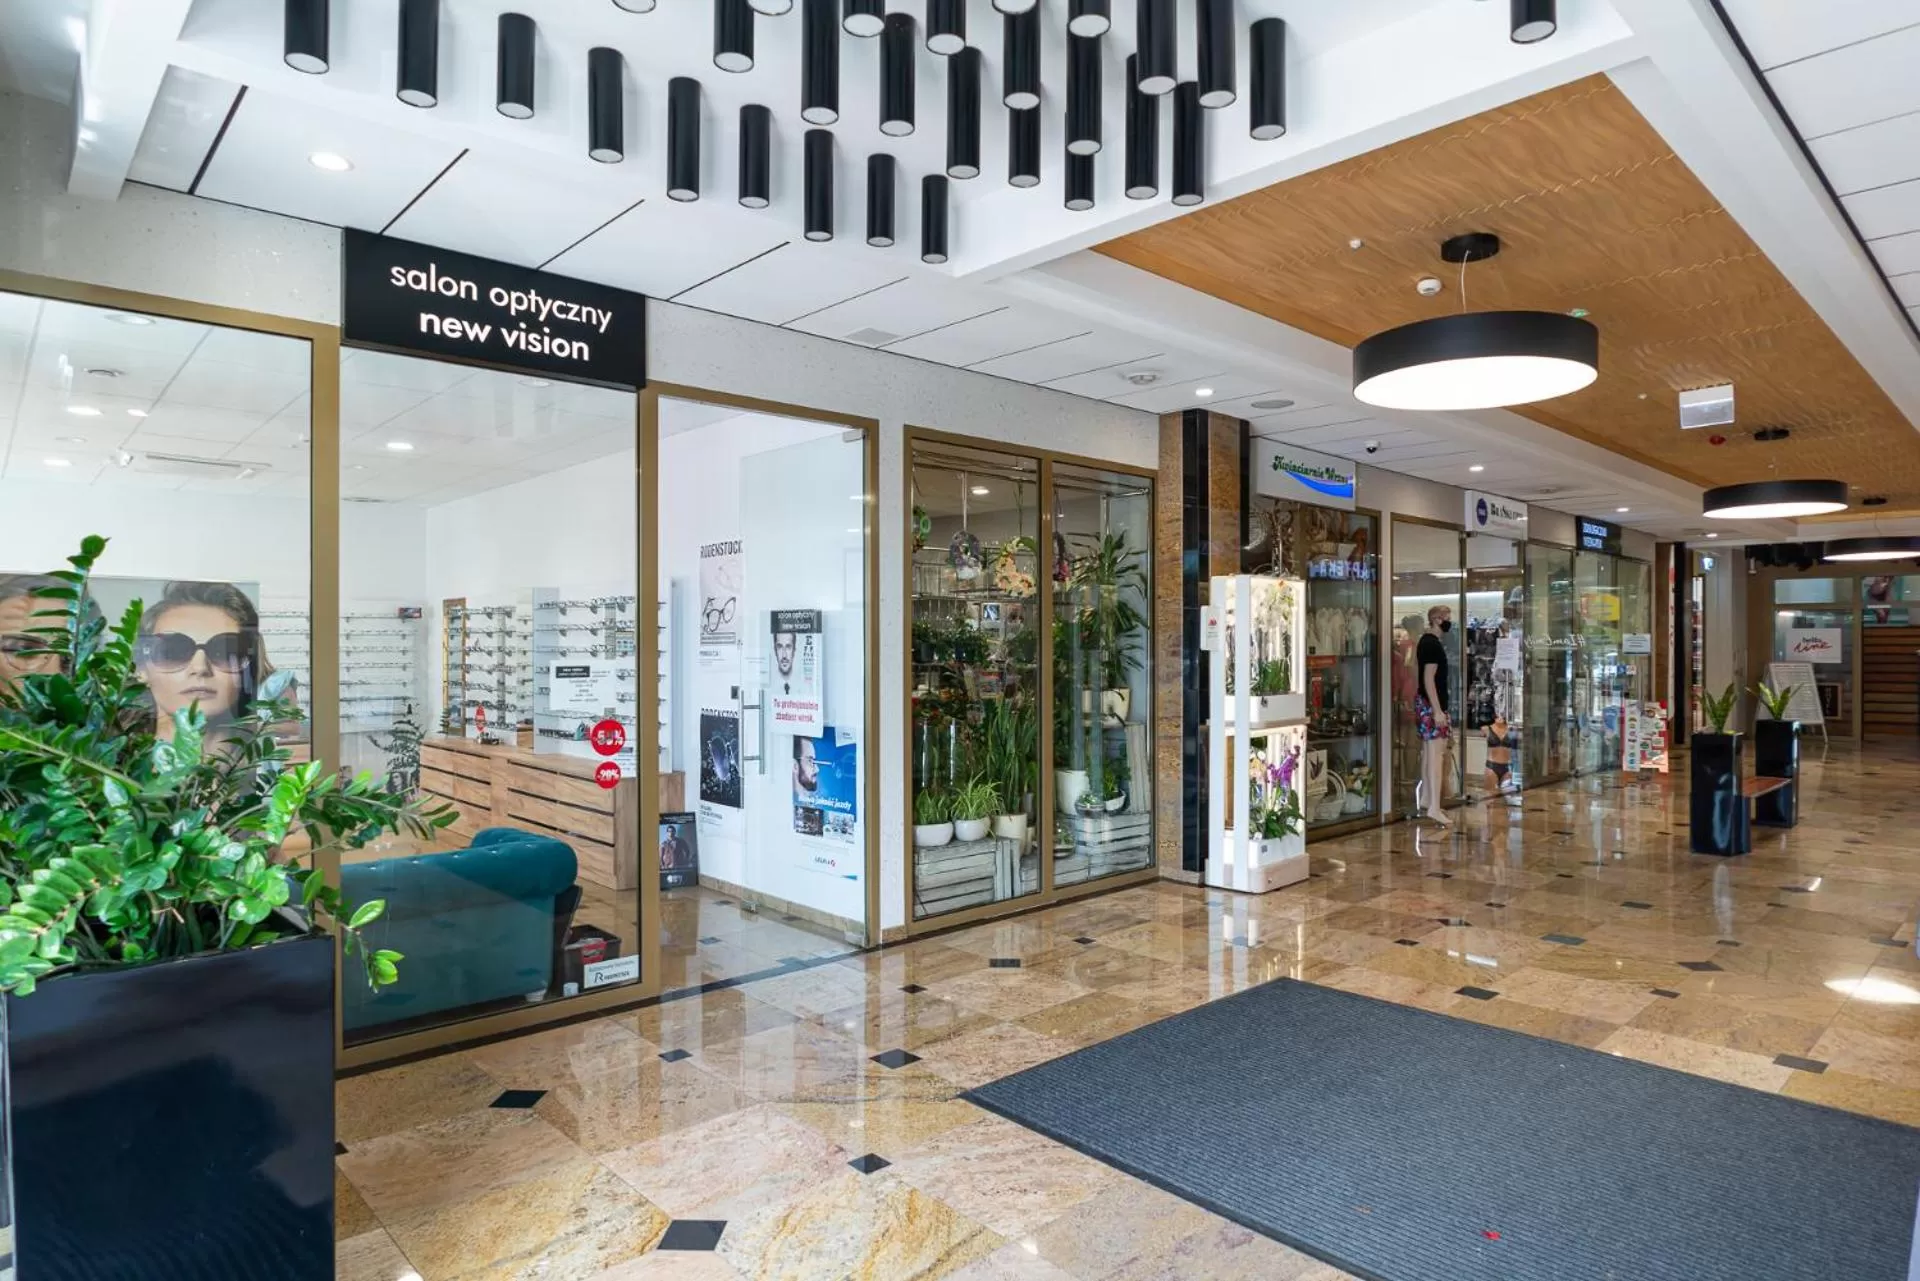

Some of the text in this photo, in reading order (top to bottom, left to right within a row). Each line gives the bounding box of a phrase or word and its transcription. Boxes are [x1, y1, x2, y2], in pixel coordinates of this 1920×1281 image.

[390, 263, 613, 334] salon optyczny
[419, 312, 590, 361] new vision
[700, 540, 743, 558] RODENSTOCK
